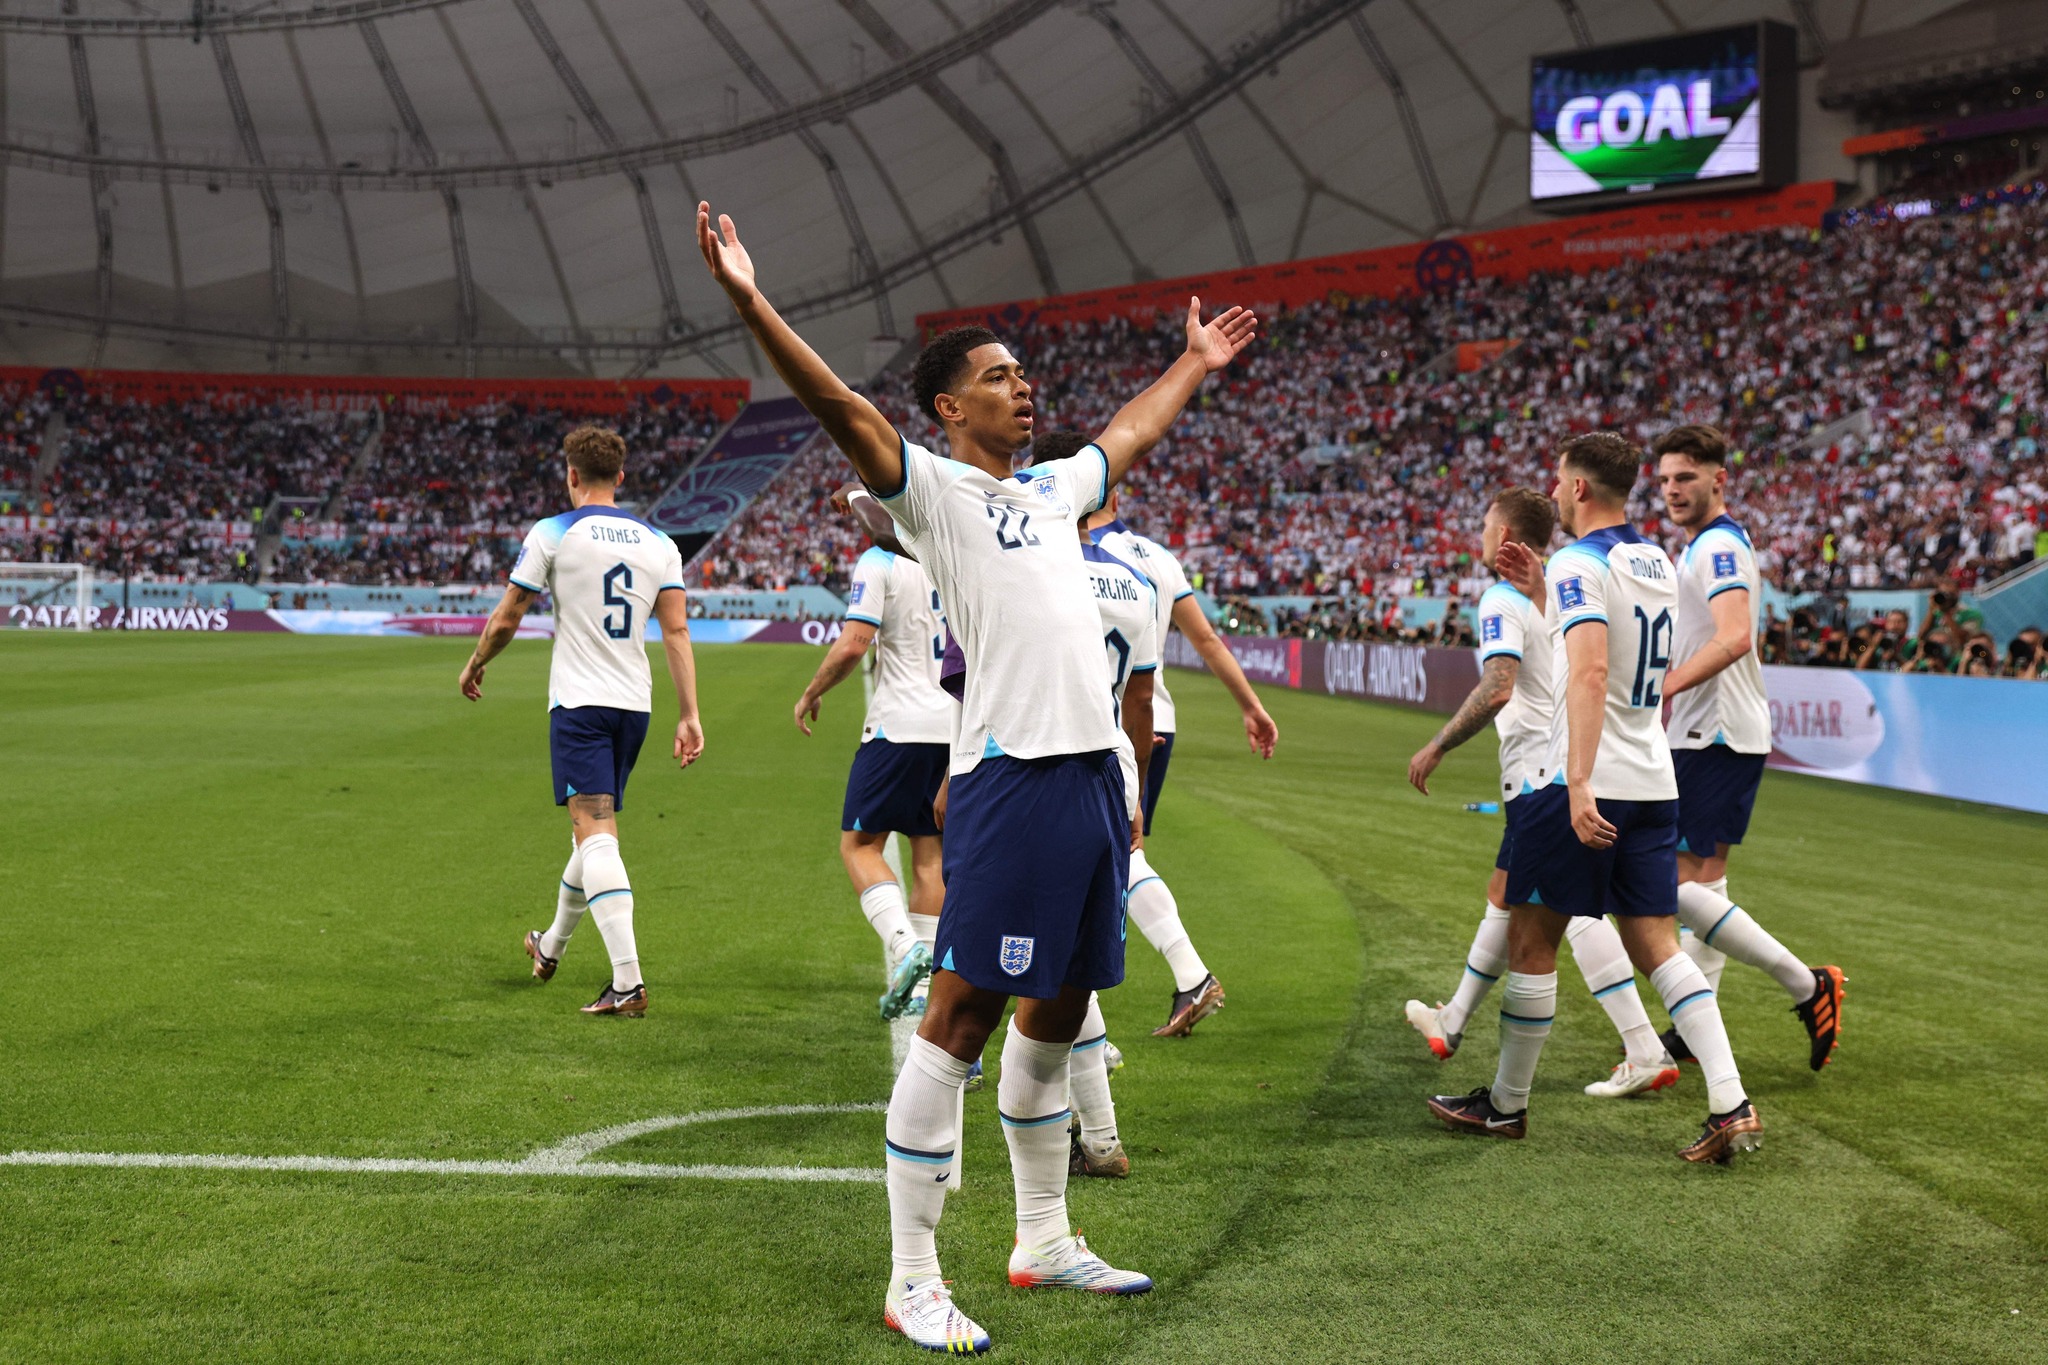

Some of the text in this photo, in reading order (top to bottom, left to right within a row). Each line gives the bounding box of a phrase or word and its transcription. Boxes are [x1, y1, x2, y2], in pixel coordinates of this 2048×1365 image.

[1555, 78, 1732, 155] GOAL
[590, 525, 641, 544] STONES
[986, 503, 1042, 551] 22
[604, 561, 633, 639] 5
[1089, 576, 1139, 601] ERLING
[9, 604, 229, 631] QATAR AIRWAYS
[1324, 641, 1365, 695] QATAR
[1366, 643, 1428, 703] AIRWAYS
[1631, 604, 1673, 708] 19
[1768, 699, 1843, 745] QATAR
